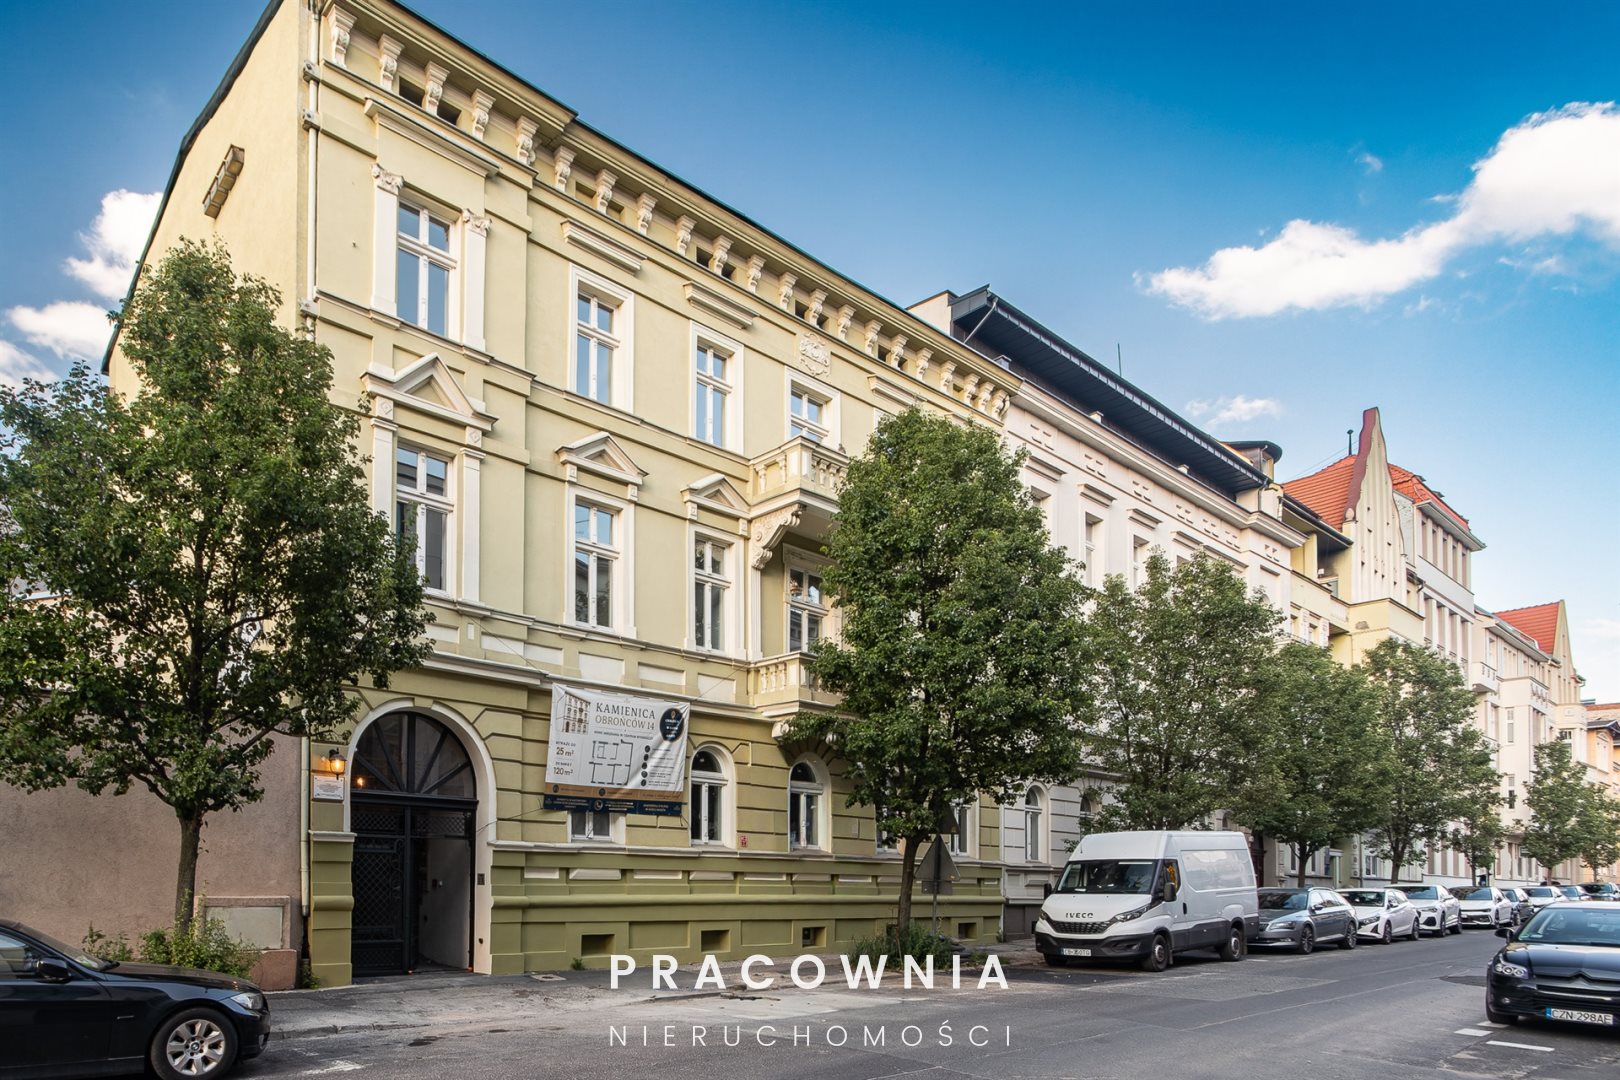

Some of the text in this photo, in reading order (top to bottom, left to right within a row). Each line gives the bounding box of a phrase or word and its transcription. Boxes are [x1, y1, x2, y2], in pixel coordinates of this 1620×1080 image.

[596, 702, 656, 719] KAMIENICA
[595, 715, 647, 729] OBROŃCÓW
[647, 721, 655, 730] 14
[556, 747, 565, 755] 25
[553, 766, 565, 775] 120
[1551, 1009, 1574, 1020] CZN
